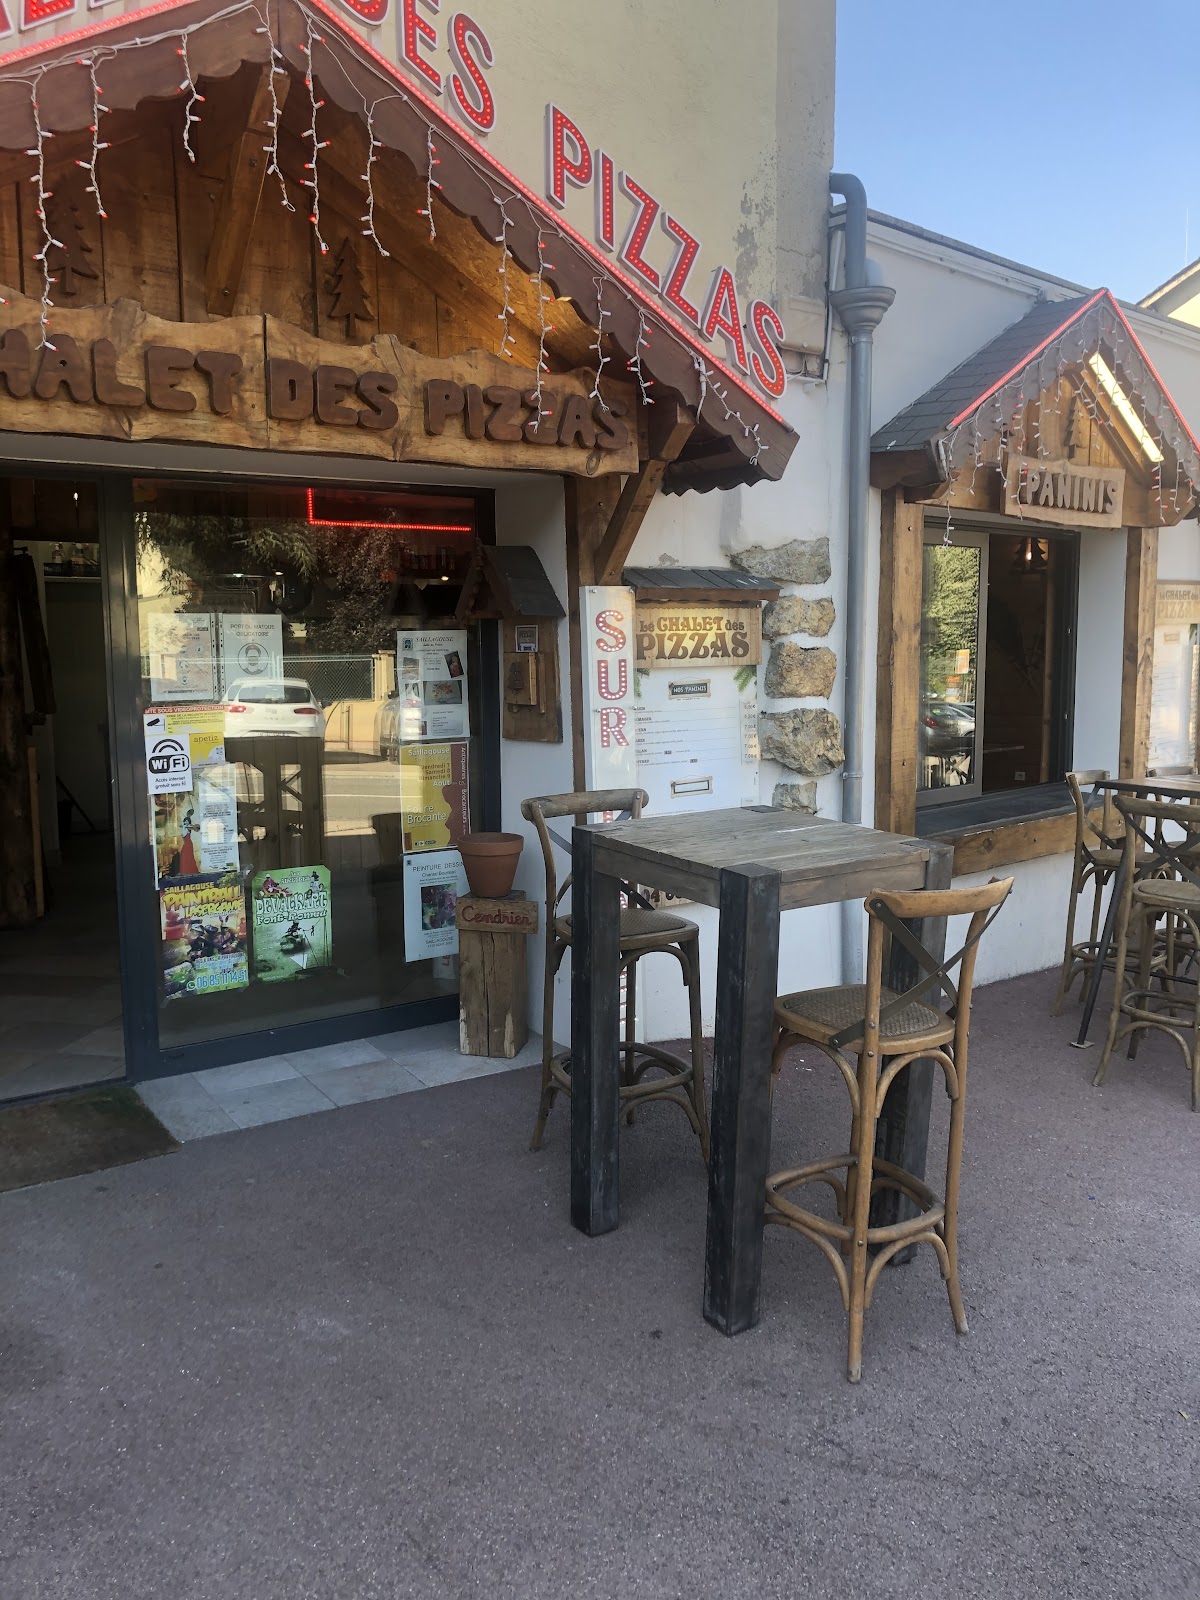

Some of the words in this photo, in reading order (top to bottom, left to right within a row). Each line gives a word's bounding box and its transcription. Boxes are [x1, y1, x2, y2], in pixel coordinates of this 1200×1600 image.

[547, 103, 788, 400] PIZZAS
[266, 356, 398, 431] DES
[424, 378, 630, 450] PIZZAS
[1024, 468, 1119, 514] PANINIS
[656, 616, 724, 632] CHALET
[724, 619, 745, 631] des
[635, 631, 750, 660] PIZZAS
[595, 609, 629, 748] SUR
[685, 684, 707, 692] PANINIS
[193, 734, 219, 744] apetiz
[408, 747, 450, 757] Saillagouse
[407, 811, 447, 824] Brocante
[412, 863, 442, 872] PEINTURE
[164, 881, 215, 894] SAILLAGOUSE
[161, 885, 241, 911] PAINTBALL
[461, 905, 533, 926] Cendrier
[196, 975, 208, 989] 06
[209, 973, 220, 987] 85
[221, 972, 229, 985] 11
[229, 970, 238, 984] 14
